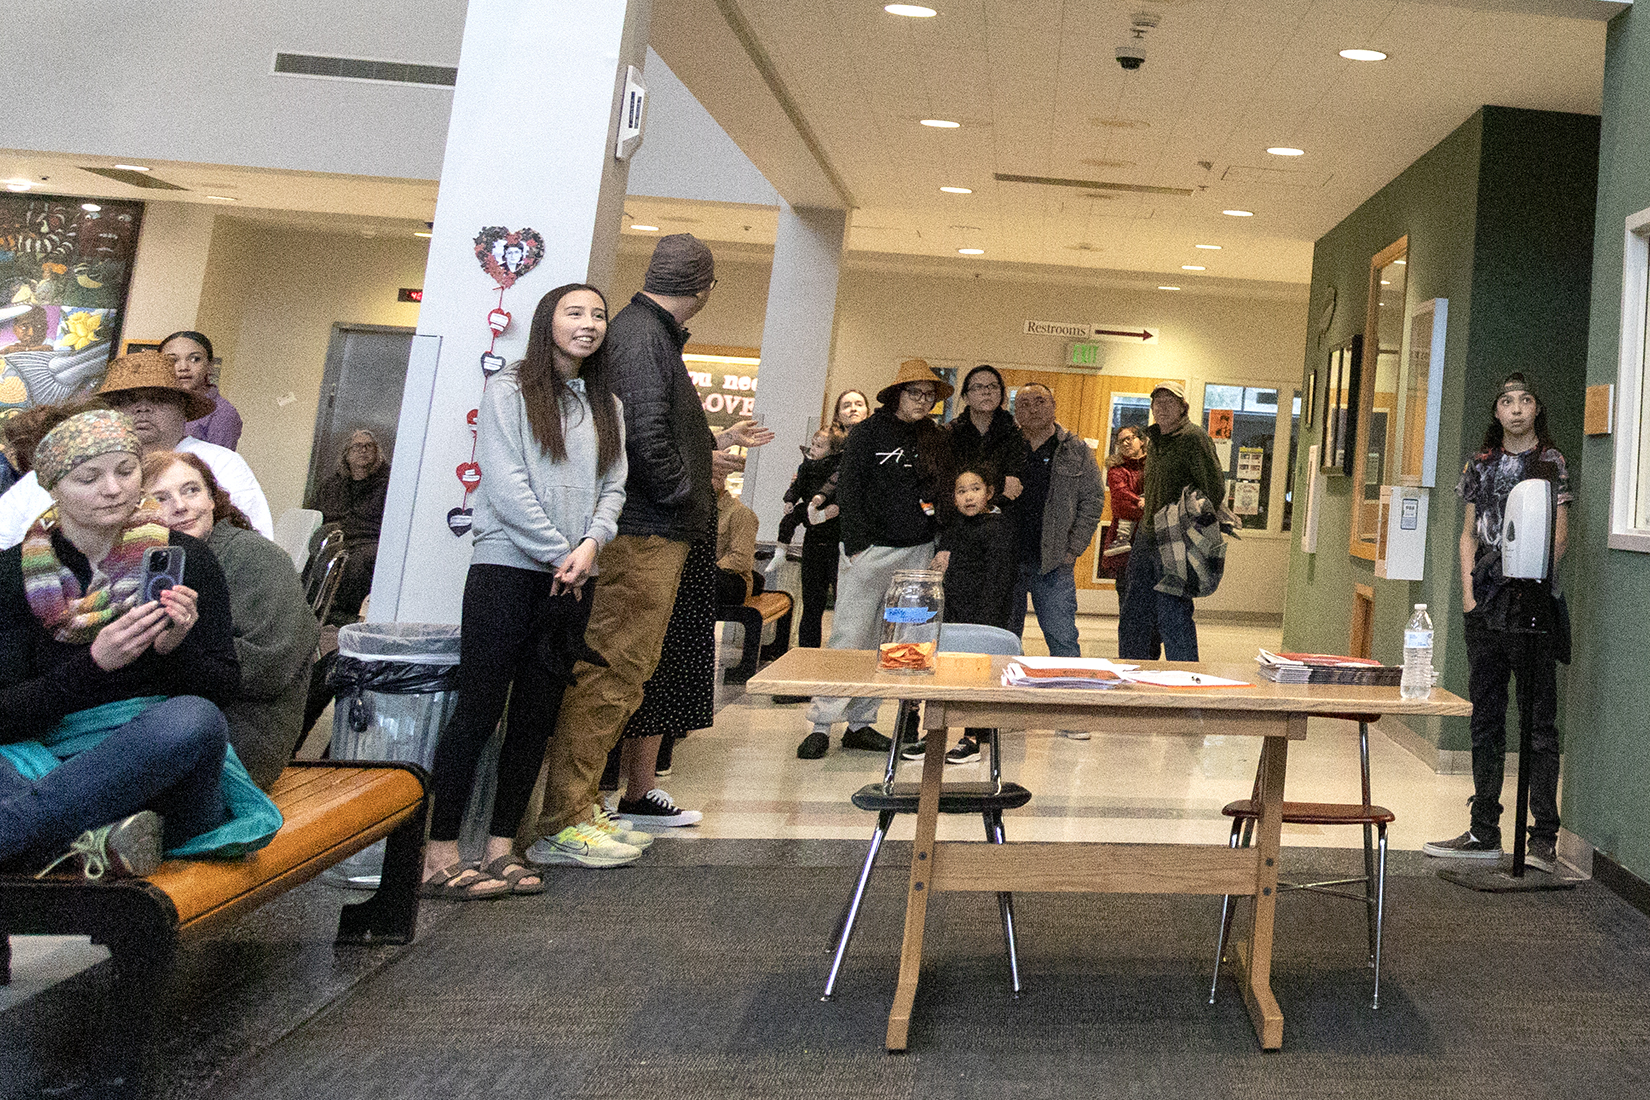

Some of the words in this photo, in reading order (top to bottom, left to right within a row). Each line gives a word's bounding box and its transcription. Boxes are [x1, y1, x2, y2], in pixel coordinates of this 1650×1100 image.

[1027, 321, 1087, 337] Restrooms
[1072, 344, 1099, 363] EXIT
[699, 392, 755, 416] OVE
